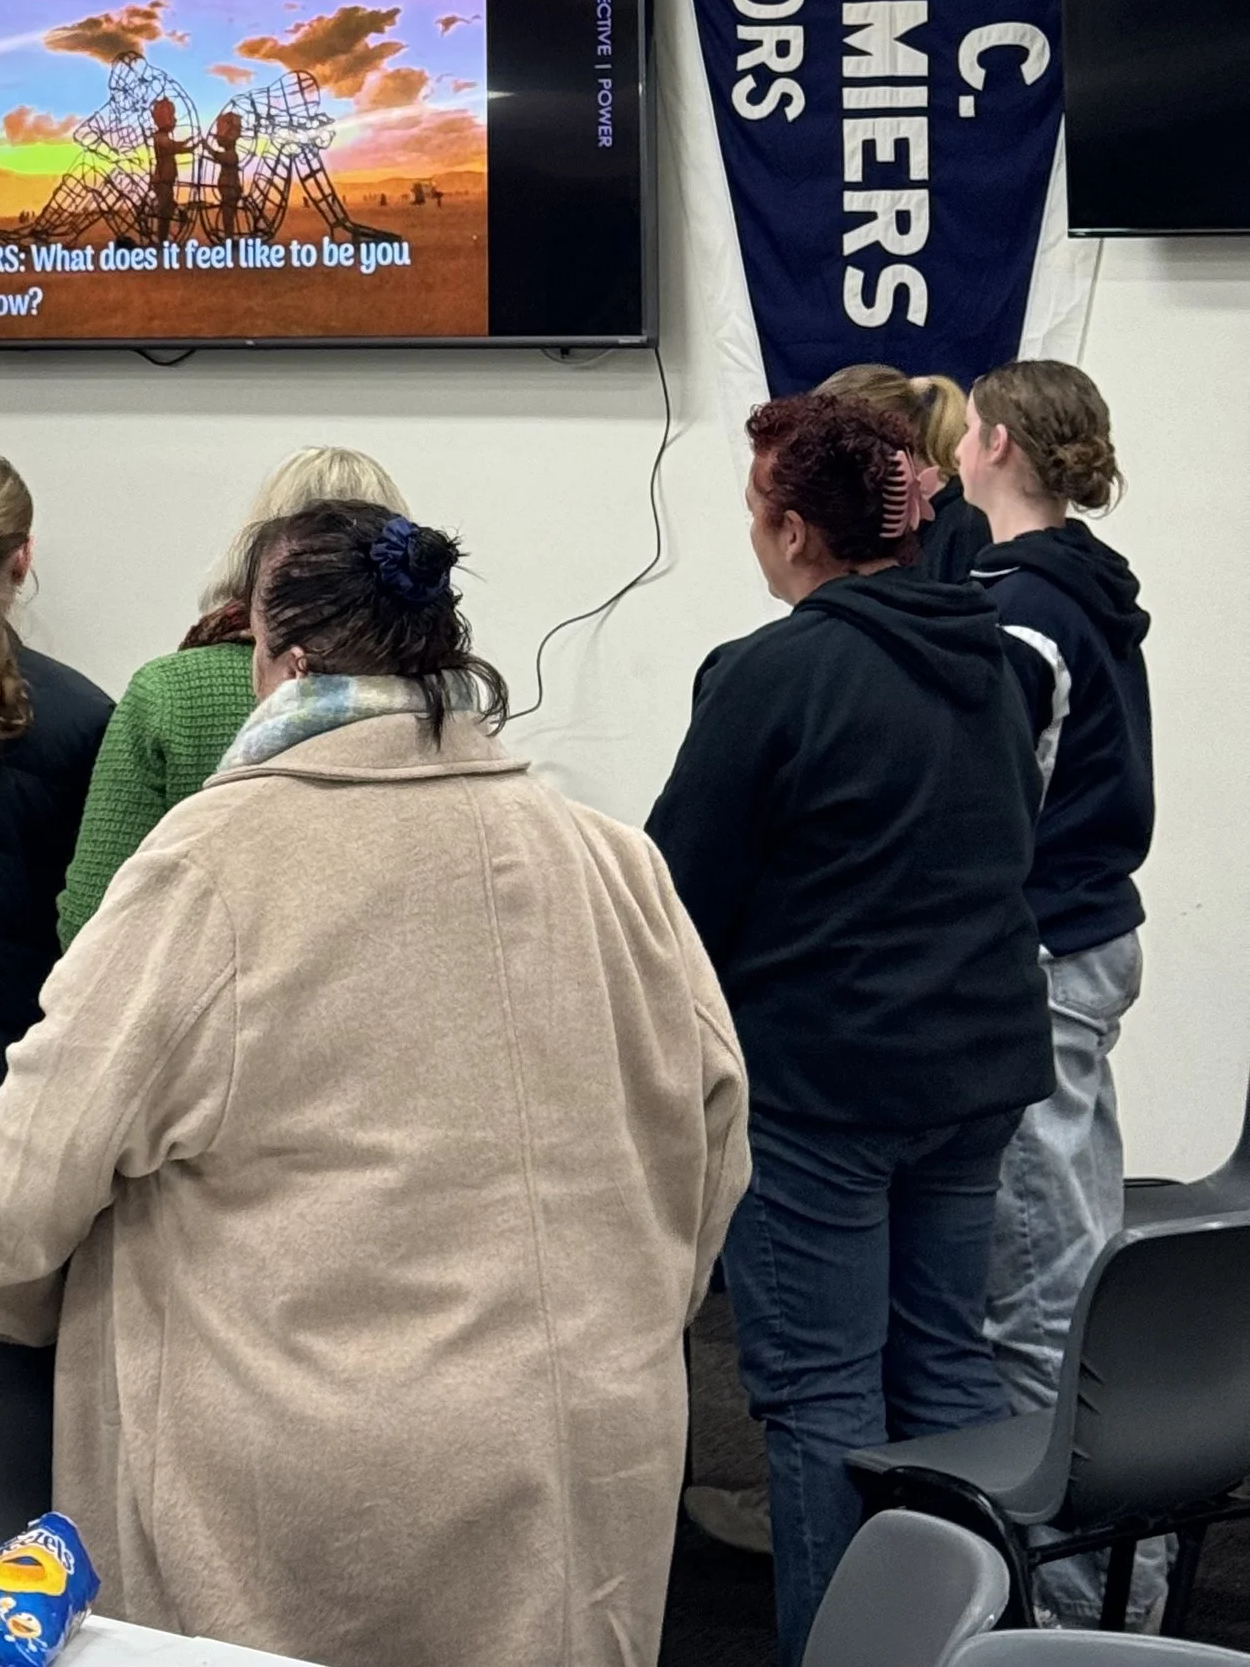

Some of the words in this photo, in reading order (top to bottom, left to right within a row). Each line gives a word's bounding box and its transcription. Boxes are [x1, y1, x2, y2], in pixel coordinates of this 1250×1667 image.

[598, 79, 612, 147] POWER
[29, 243, 94, 272] What
[100, 241, 157, 271] does
[162, 240, 180, 269] it
[185, 238, 234, 269] feel
[239, 237, 285, 268] like
[290, 240, 317, 267] to
[322, 236, 354, 267] be
[360, 240, 411, 274] you
